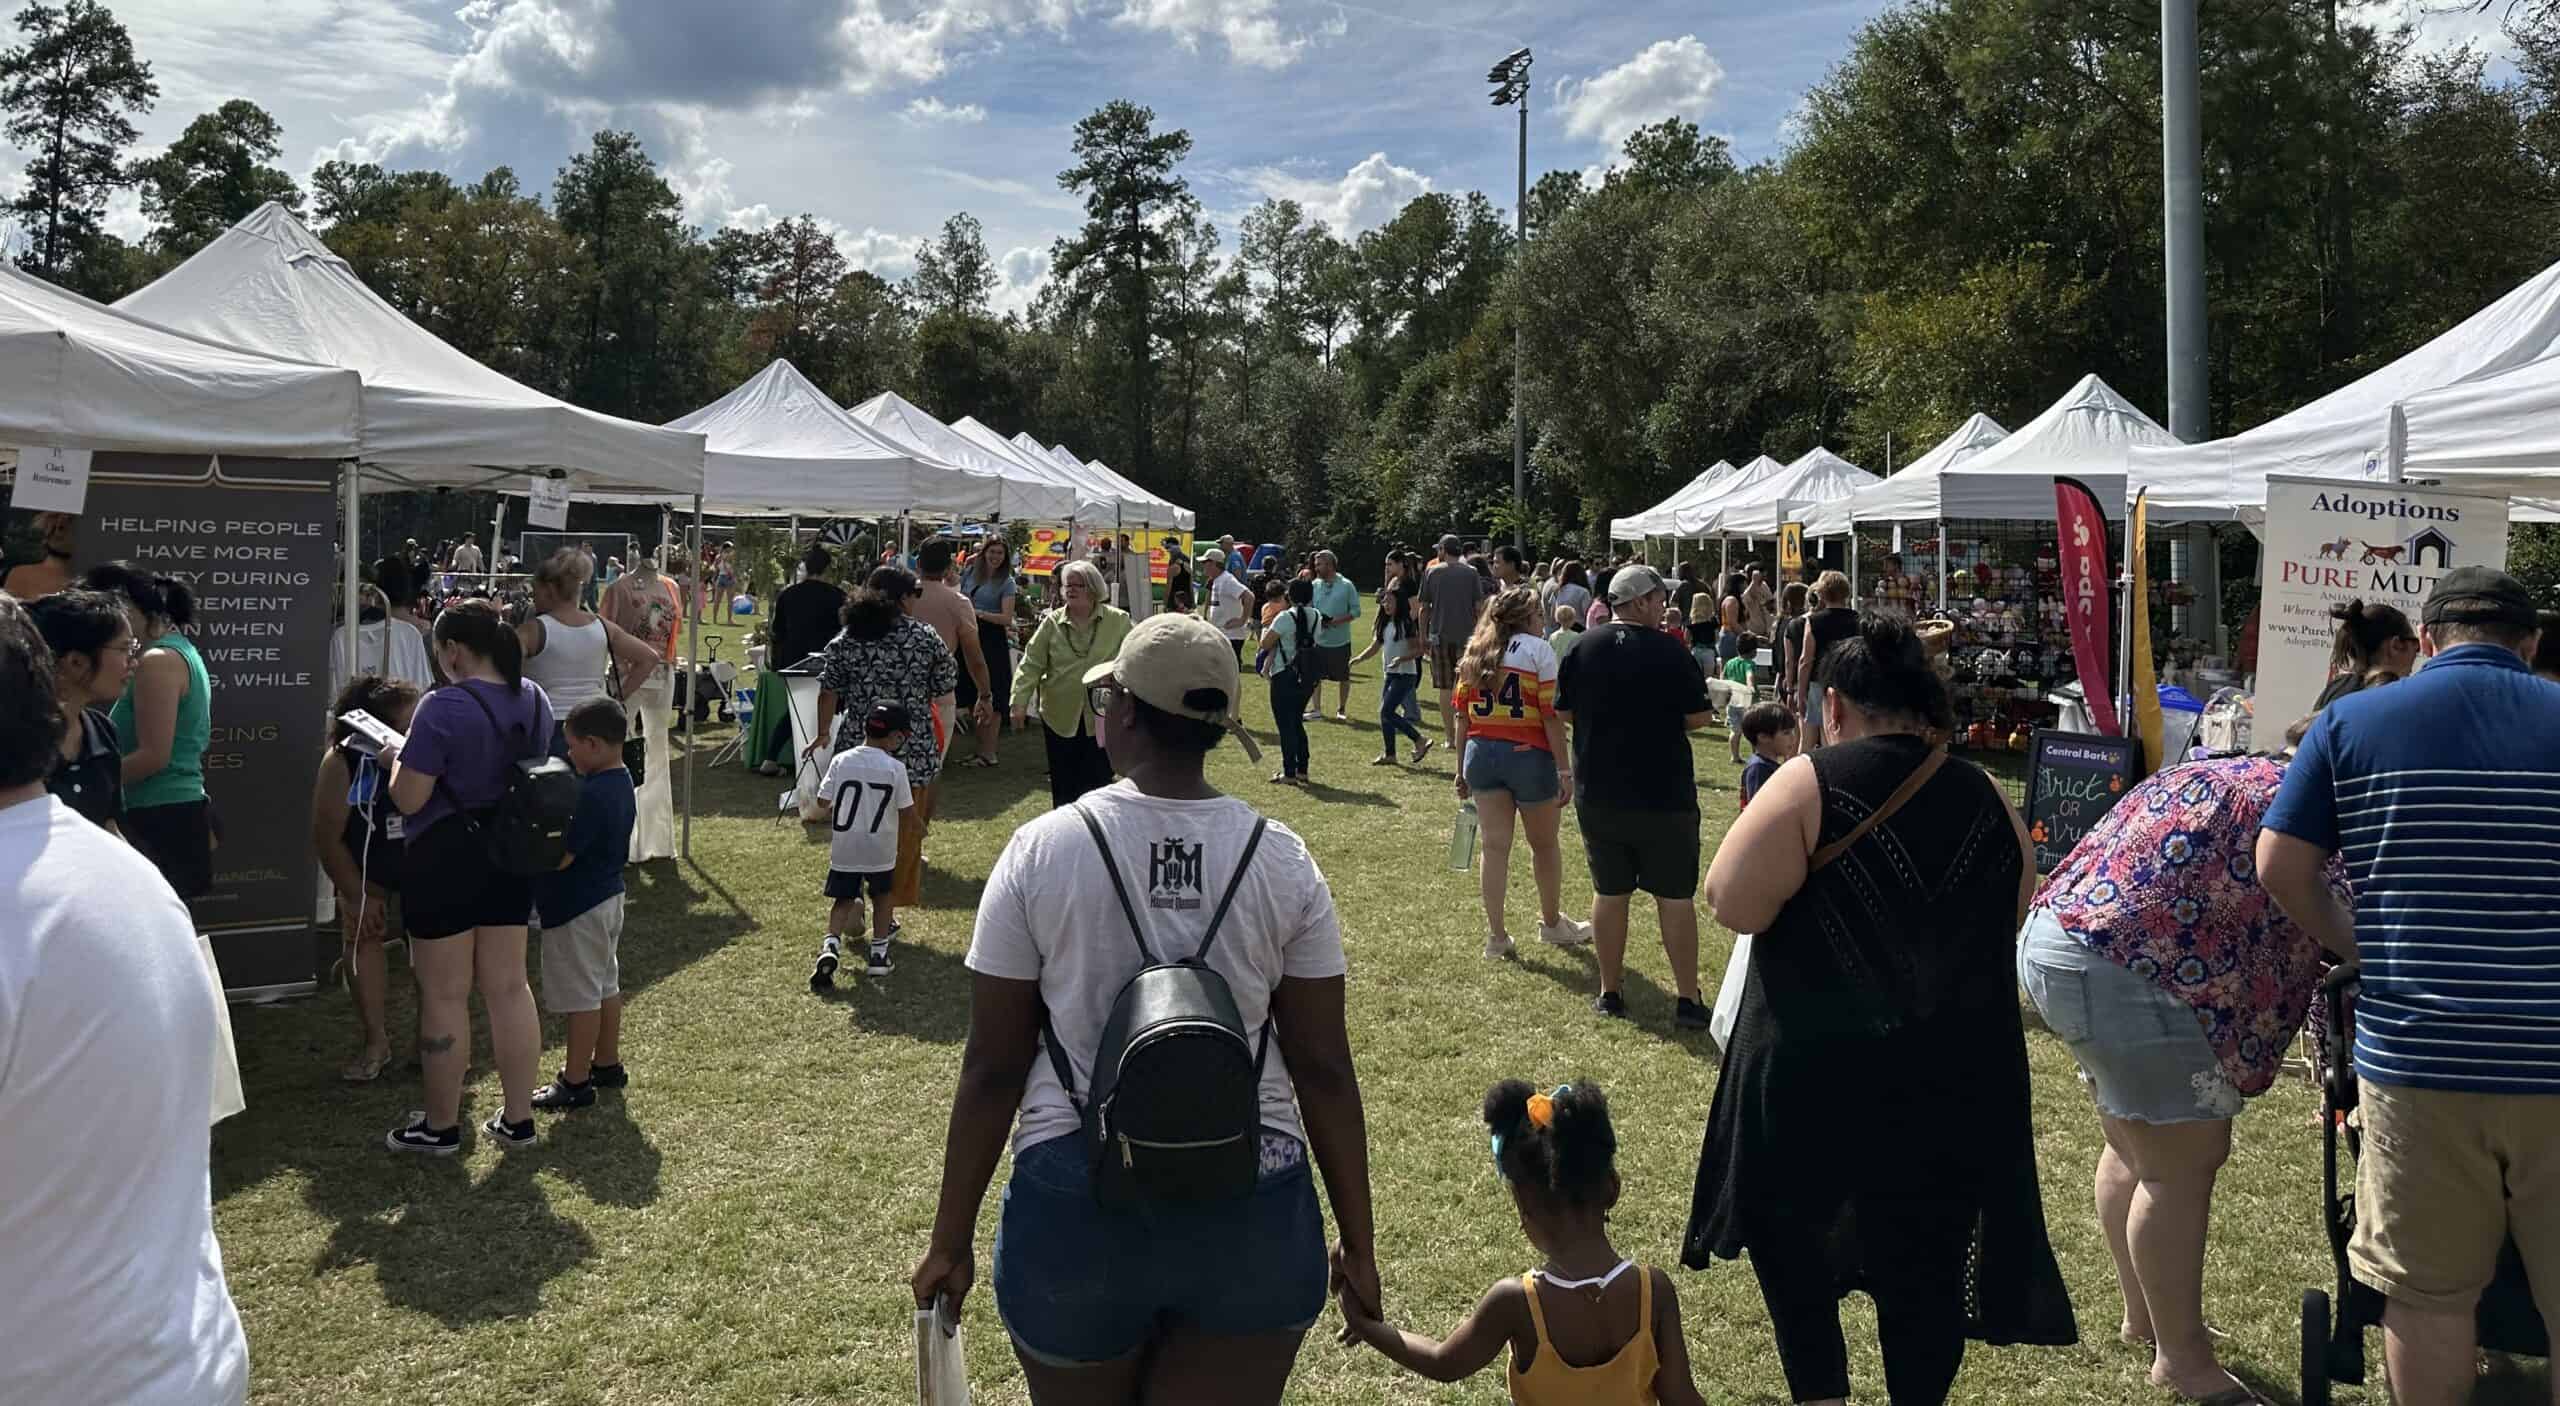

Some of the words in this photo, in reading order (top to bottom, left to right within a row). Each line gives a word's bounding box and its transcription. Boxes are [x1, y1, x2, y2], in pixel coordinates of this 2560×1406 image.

[2311, 492, 2460, 522] Adoptions
[101, 516, 217, 534] HELPING
[224, 520, 323, 536] PEOPLE
[136, 544, 206, 559] HAVE
[213, 546, 289, 561] MORE
[152, 570, 205, 585] NEY
[212, 571, 311, 586] DURING
[2281, 560, 2360, 589] PURE
[2369, 568, 2441, 594] MUT
[193, 597, 293, 611] REMENT
[2282, 603, 2316, 616] Where
[167, 623, 201, 637] AN
[209, 623, 285, 637] WHEN
[208, 648, 281, 662] WERE
[234, 672, 312, 687] WHILE
[210, 726, 279, 743] CING
[2046, 745, 2082, 758] Central
[2083, 749, 2108, 761] Bark
[833, 780, 893, 832] 07
[2060, 800, 2080, 816] OR
